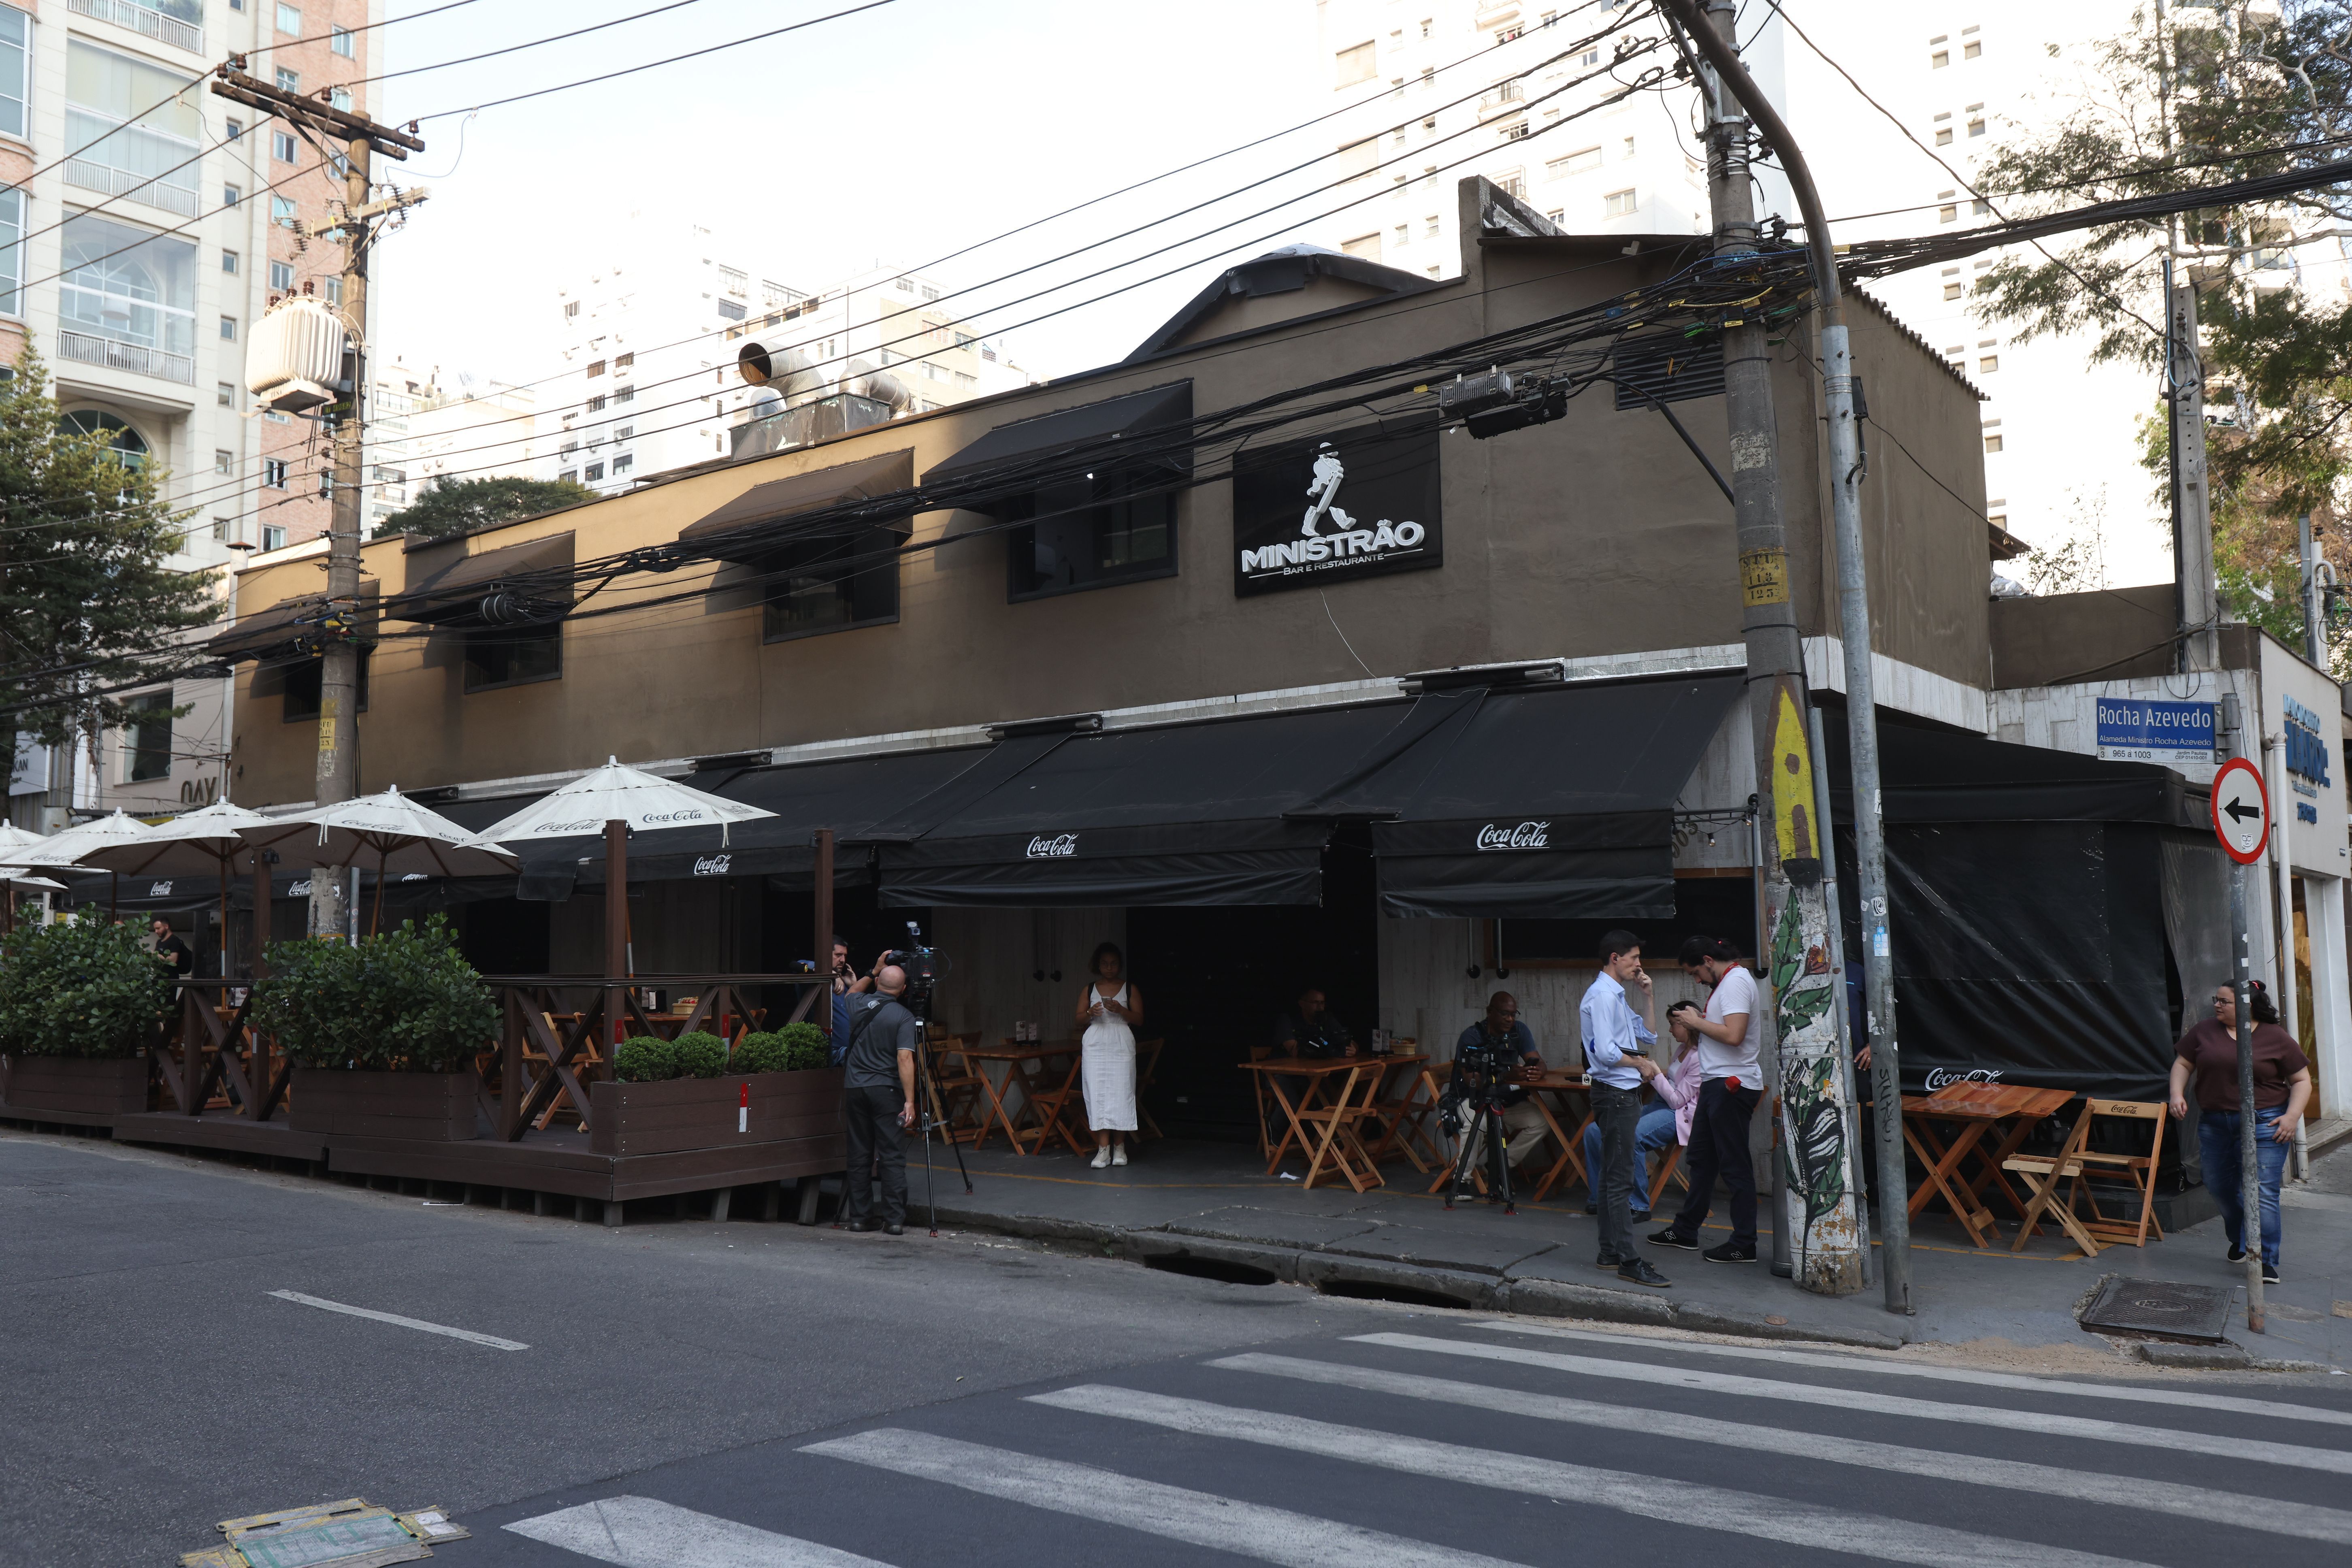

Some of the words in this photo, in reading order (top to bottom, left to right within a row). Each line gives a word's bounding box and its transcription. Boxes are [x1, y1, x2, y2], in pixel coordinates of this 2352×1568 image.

[1242, 519, 1425, 572] MINISTRÃO
[1283, 565, 1304, 575] BAR
[1314, 553, 1385, 571] RESTAURANTE
[2099, 705, 2139, 726] Rocha
[2145, 708, 2211, 728] Azevedo
[534, 818, 606, 832] Coca-Cola
[642, 809, 703, 823] Coca-Cola
[1027, 833, 1079, 858] Coca-Cola
[694, 854, 732, 875] Coca-Cola
